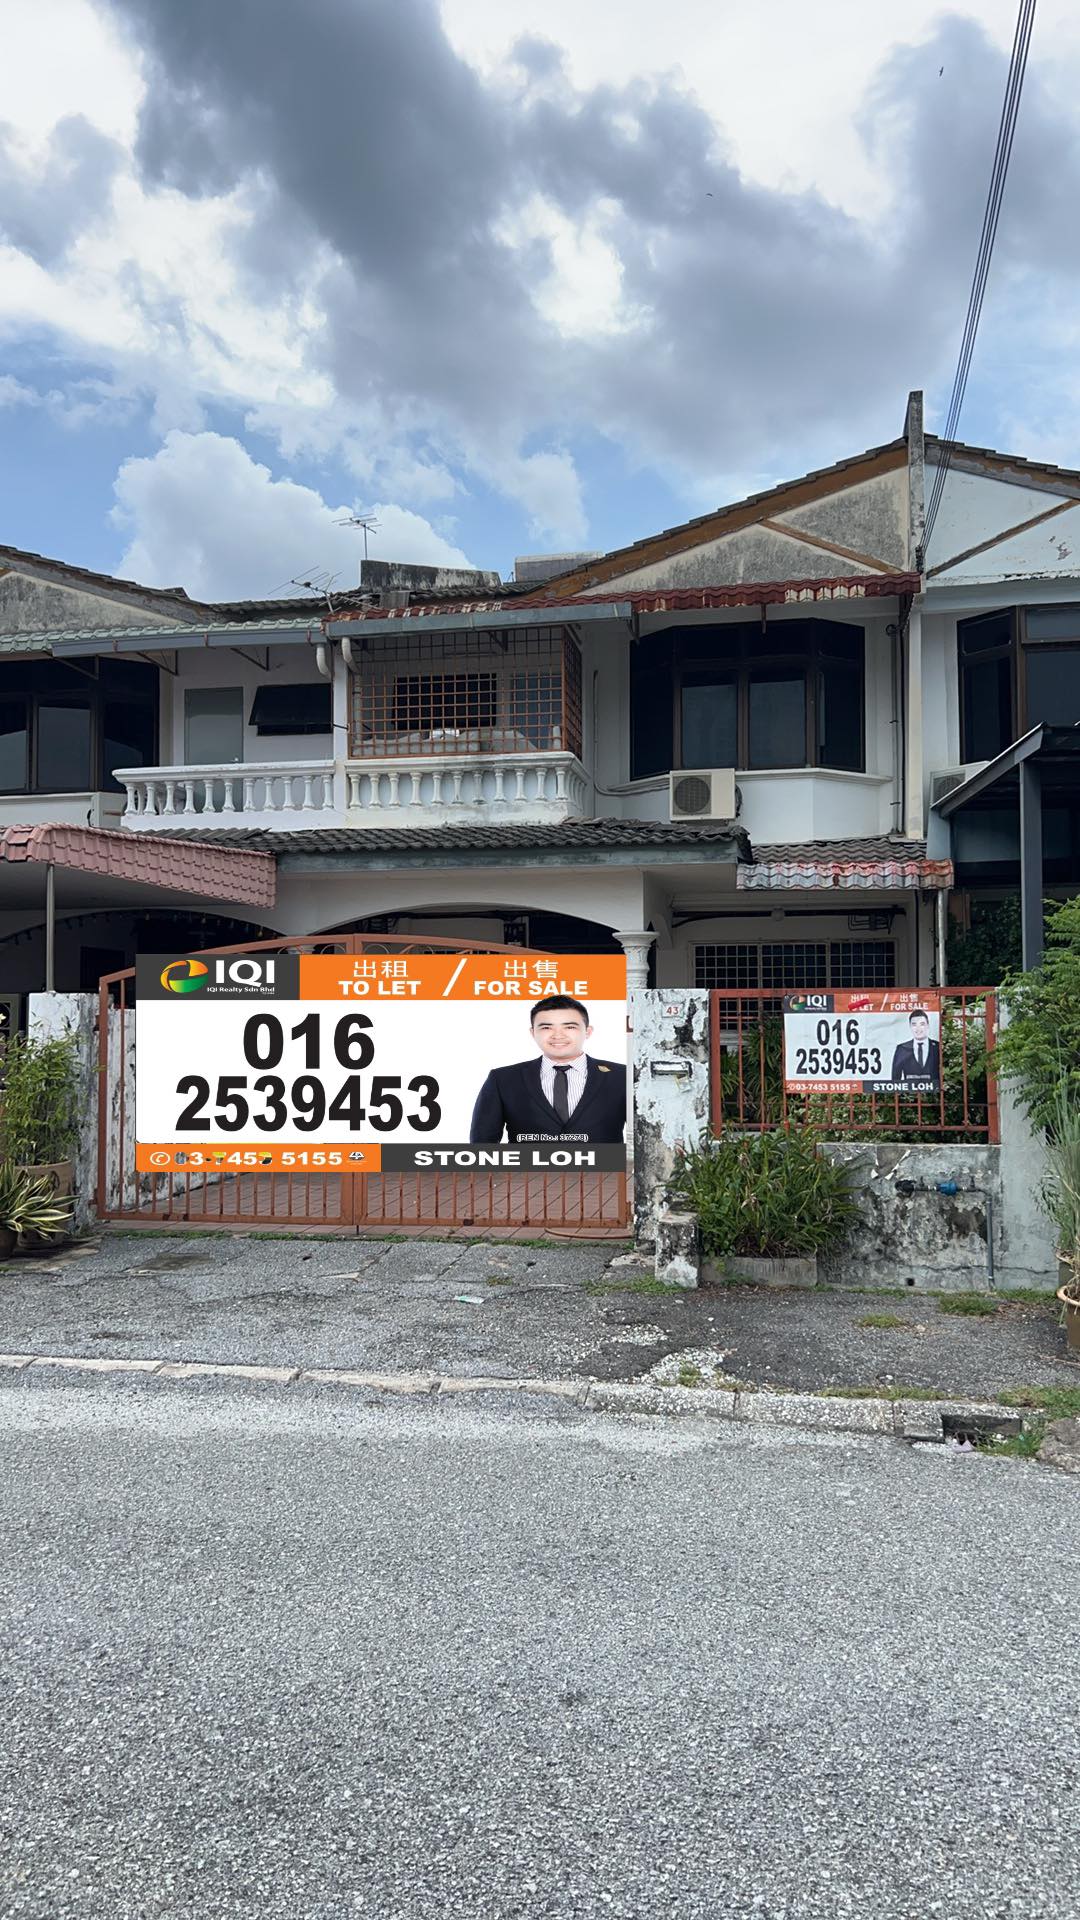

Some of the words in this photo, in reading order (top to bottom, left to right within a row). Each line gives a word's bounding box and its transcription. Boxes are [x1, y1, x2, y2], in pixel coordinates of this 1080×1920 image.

[807, 994, 828, 1008] IQI
[666, 1006, 679, 1015] 43
[890, 1003, 906, 1011] FOR
[908, 1002, 929, 1010] SALE
[816, 1018, 860, 1047] 016
[795, 1047, 882, 1075] 2539453
[795, 1083, 829, 1091] 03-7453
[830, 1083, 851, 1091] 5155
[873, 1082, 909, 1091] STONE
[911, 1082, 934, 1091] LOH
